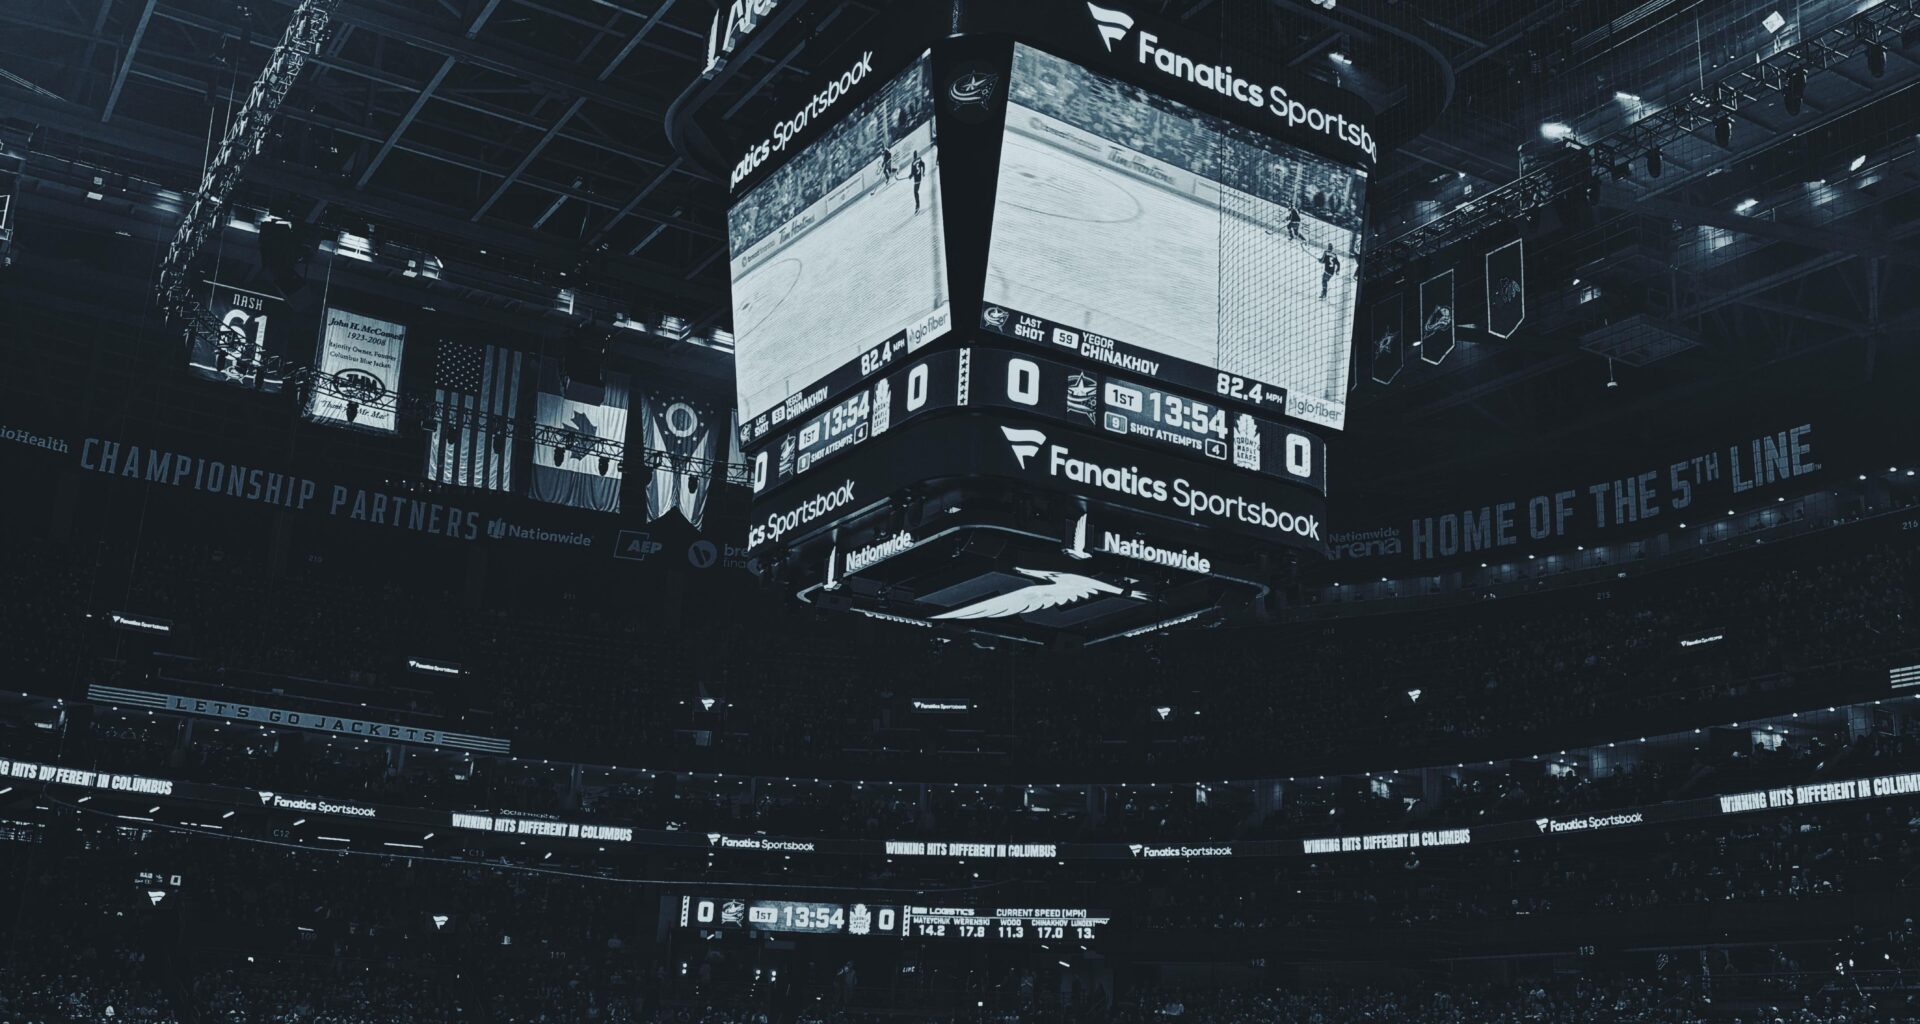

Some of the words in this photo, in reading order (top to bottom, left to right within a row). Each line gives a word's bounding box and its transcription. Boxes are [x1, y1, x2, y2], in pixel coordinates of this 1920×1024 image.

[1138, 30, 1265, 108] Fanatics
[772, 50, 873, 151] Sportsbook
[233, 293, 263, 311] NASH
[328, 317, 349, 328] John
[349, 322, 360, 331] H.
[1014, 322, 1046, 343] SHOT
[1020, 315, 1042, 330] LAST
[347, 331, 386, 346] 1923-2008
[1058, 332, 1074, 345] 59
[1081, 331, 1115, 351] YEGOR
[861, 340, 892, 376] 82.4
[892, 338, 905, 352] MPH
[1080, 343, 1160, 377] CHINAKHOV
[907, 363, 928, 412] 0
[1006, 358, 1040, 406] 0
[1216, 371, 1264, 404] 82.4
[1265, 391, 1283, 405] MPH
[786, 386, 828, 421] CHINAKHOV
[803, 429, 815, 445] 1ST
[823, 390, 870, 440] 13:54
[1112, 388, 1135, 407] 1ST
[1150, 391, 1228, 439] 13:54
[754, 421, 769, 437] SHOT
[1111, 417, 1121, 429] 9
[1130, 421, 1155, 438] SHOT
[1155, 427, 1203, 451] ATTEMPTS
[1211, 444, 1221, 456] 4
[811, 447, 825, 463] SHOT
[825, 434, 853, 455] ATTEMPTS
[1285, 433, 1312, 478] 0
[753, 451, 768, 493] 0
[80, 437, 316, 510] CHAMPIONSHIP
[329, 484, 480, 541] PARTNERS
[1050, 444, 1168, 502] Fanatics
[1172, 478, 1321, 541] Sportsbook
[1412, 502, 1517, 561] HOME
[1528, 489, 1576, 540] OF
[1589, 470, 1660, 528] THE
[1670, 452, 1719, 510] 5TH
[1730, 423, 1815, 494] LINE
[766, 478, 855, 542] Sportsbook
[508, 524, 592, 547] Nationwide
[627, 539, 663, 555] AEP
[1328, 527, 1400, 544] Nationwide
[846, 529, 914, 574] Nationwide
[1103, 531, 1212, 574] Nationwide
[176, 698, 249, 718] LET'S
[270, 711, 300, 724] GO
[315, 717, 436, 742] JACKETS
[11, 762, 38, 779] HITS
[39, 765, 97, 787] DIFERENT
[97, 773, 110, 789] IN
[111, 775, 173, 795] COLUMBUS
[273, 795, 317, 811] Fanatics
[317, 801, 376, 818] Sportsbook
[1720, 792, 1767, 813] WINNING
[1769, 788, 1794, 807] HITS
[1796, 781, 1856, 804] DIFFERENT
[1857, 779, 1871, 797] IN
[452, 813, 493, 831] WINNING
[494, 818, 517, 833] HITS
[517, 819, 568, 838] DIFFERENT
[568, 824, 580, 838] IN
[580, 825, 633, 842] COLUMBUS
[1550, 817, 1588, 832] Fanatics
[1588, 812, 1643, 829] Sportsbook
[721, 836, 760, 849] Fanatics
[760, 839, 815, 852] Sportsbook
[886, 841, 925, 855] WINNING
[926, 842, 948, 856] HITS
[949, 843, 995, 857] DIFFERENT
[996, 844, 1007, 858] IN
[1008, 844, 1057, 858] COLUMBUS
[1143, 846, 1180, 858] Fanatics
[1180, 846, 1232, 858] Sportsbook
[1303, 838, 1340, 854] WINNING
[1341, 837, 1362, 851] HITS
[1363, 833, 1408, 850] DIFFERENT
[1409, 832, 1420, 847] IN
[1421, 828, 1471, 847] COLUMBUS
[697, 901, 714, 923] 0
[756, 911, 772, 921] 1ST
[783, 906, 845, 929] 13:54
[878, 909, 895, 931] 0
[929, 908, 975, 916] LOGISTICS
[996, 908, 1034, 917] CURRENT
[1034, 908, 1060, 918] SPEED
[953, 918, 990, 926] WERENSKI
[1031, 919, 1068, 927] CHINAKHOV
[919, 925, 946, 936] 14.2
[959, 925, 985, 937] 17.8
[998, 926, 1024, 938] 11.3
[1037, 927, 1063, 939] 17.0
[1579, 945, 1595, 956] 113
